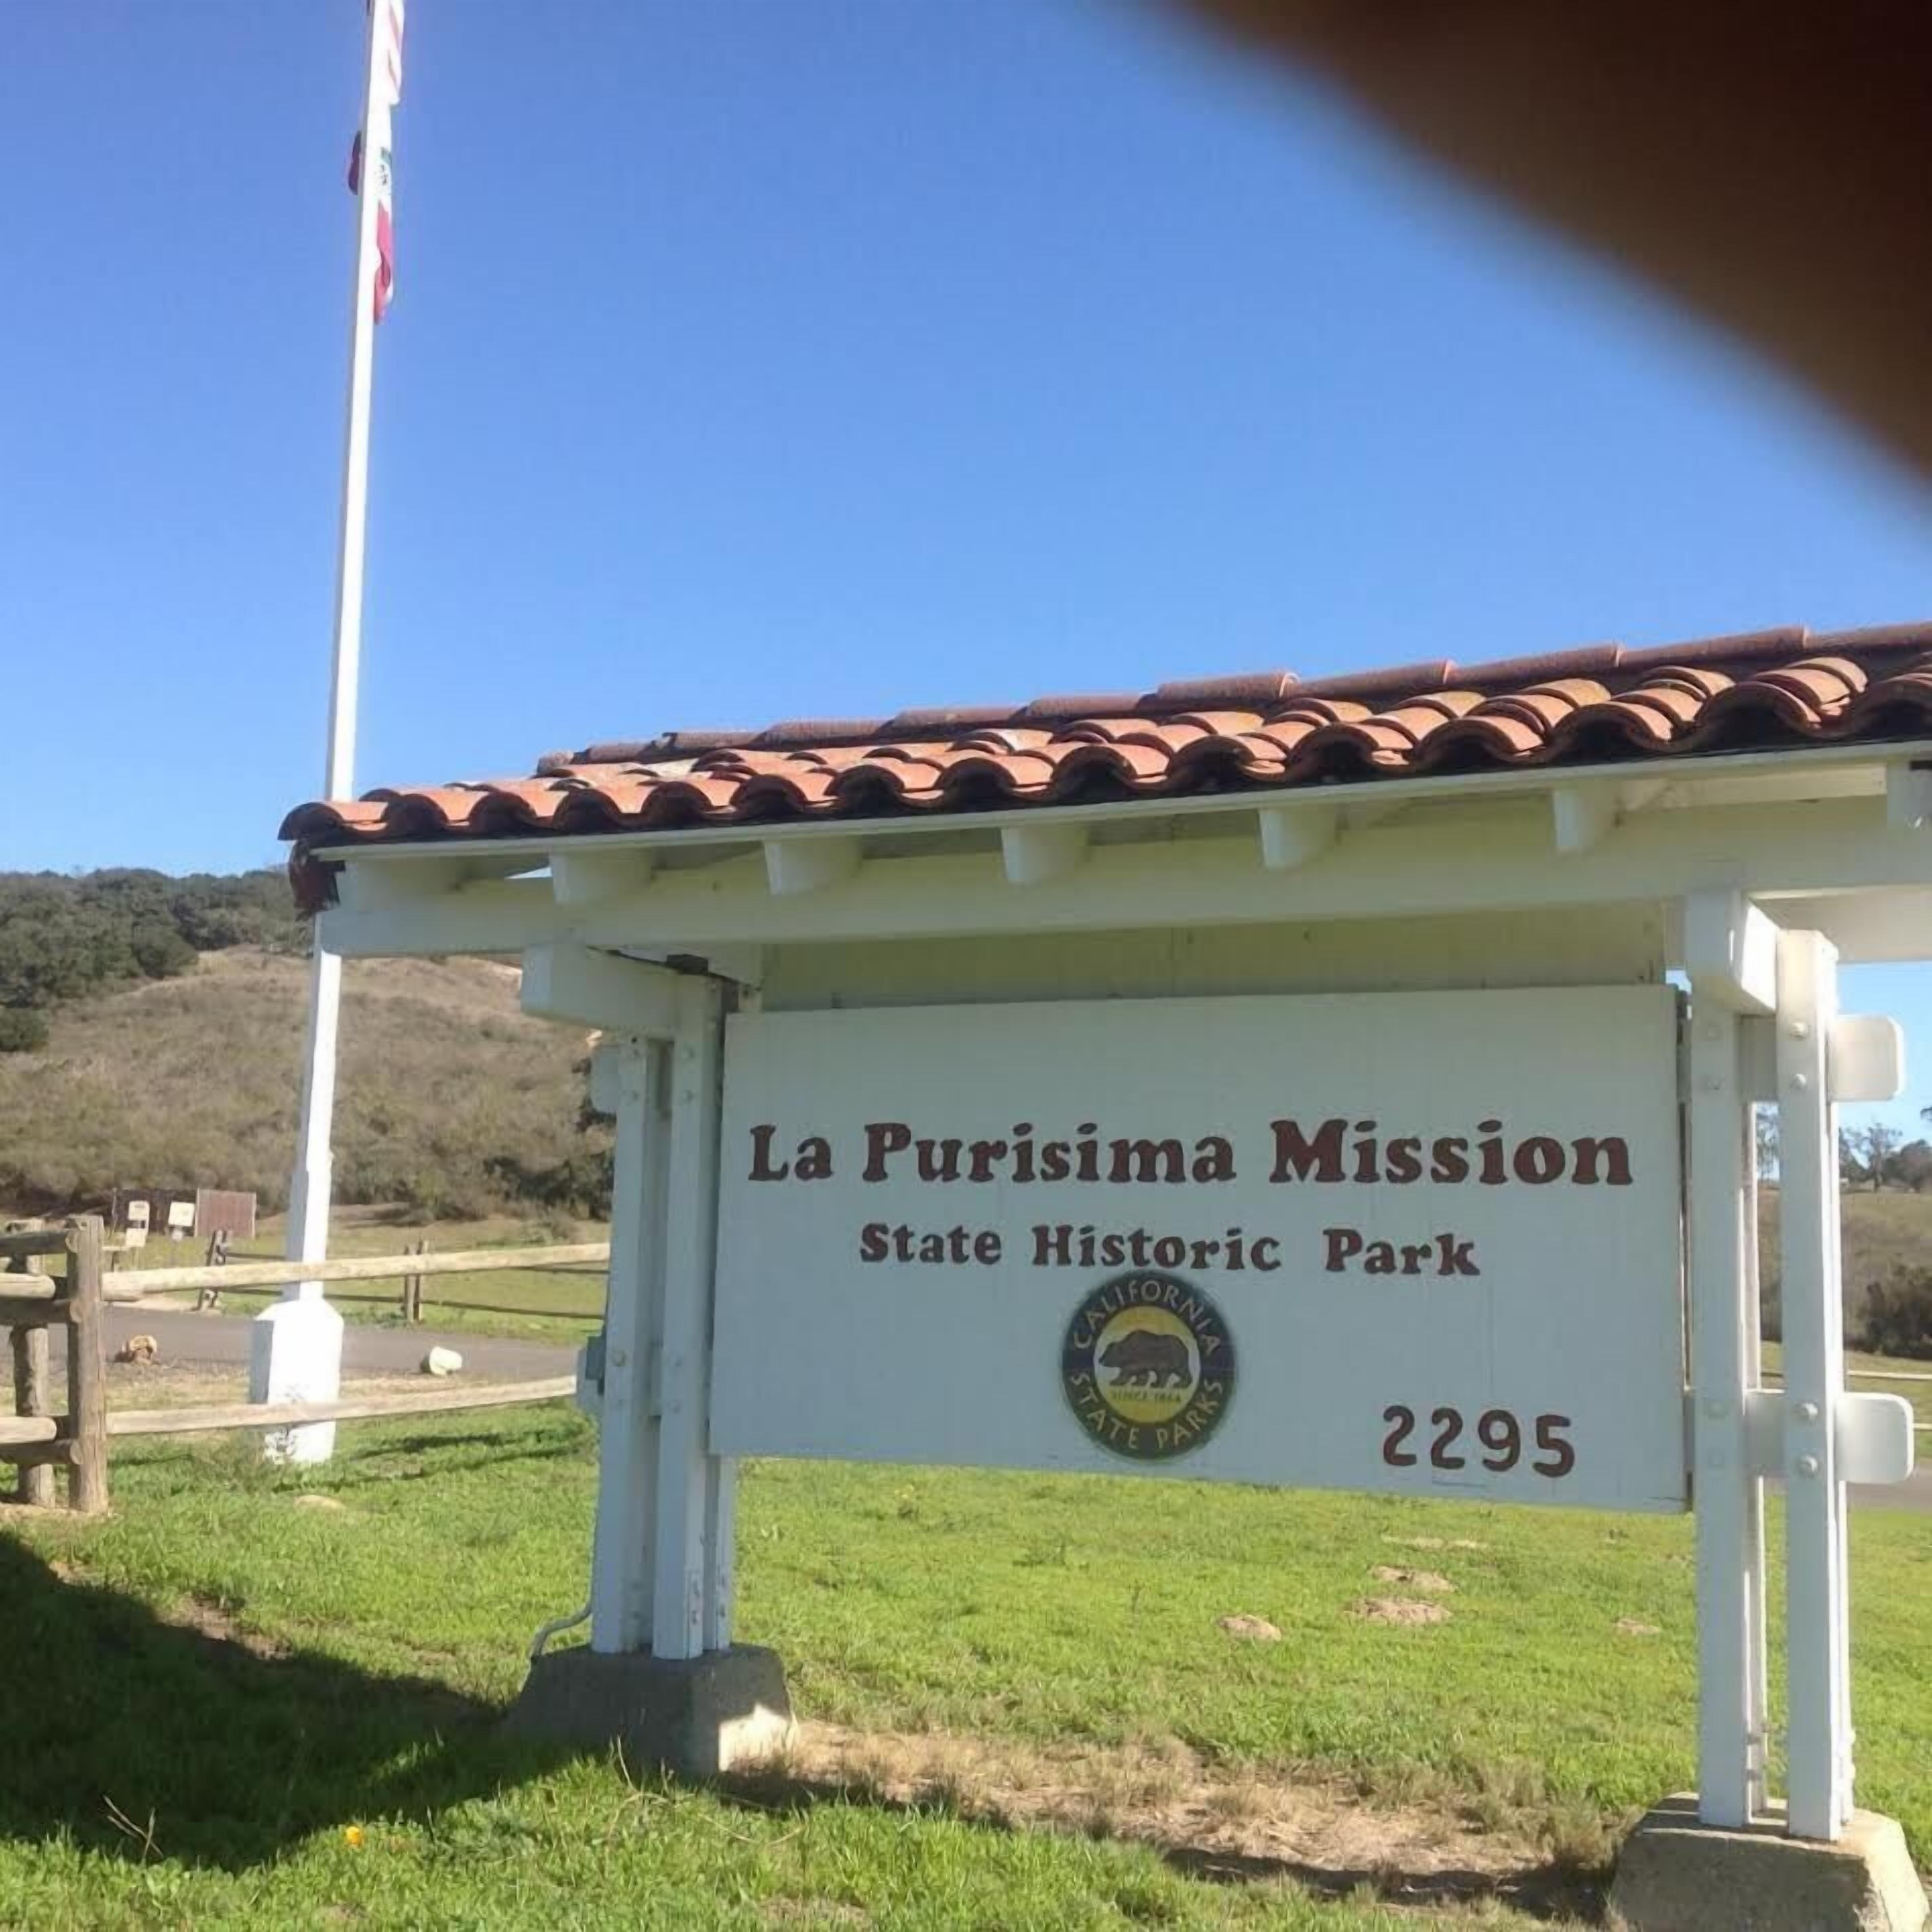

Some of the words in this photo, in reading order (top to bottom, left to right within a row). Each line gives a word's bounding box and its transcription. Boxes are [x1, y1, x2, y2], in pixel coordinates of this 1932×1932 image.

[748, 1124, 833, 1182] La
[862, 1122, 1236, 1184] Purisima
[1270, 1119, 1634, 1185] Mission
[860, 1223, 1002, 1265] State
[1032, 1225, 1281, 1271] Historic
[1323, 1228, 1480, 1276] Park
[1074, 1280, 1220, 1355] CALIFORNIA
[1070, 1372, 1140, 1450] STATE
[1156, 1378, 1223, 1450] PARKS
[1383, 1405, 1575, 1478] 2295
